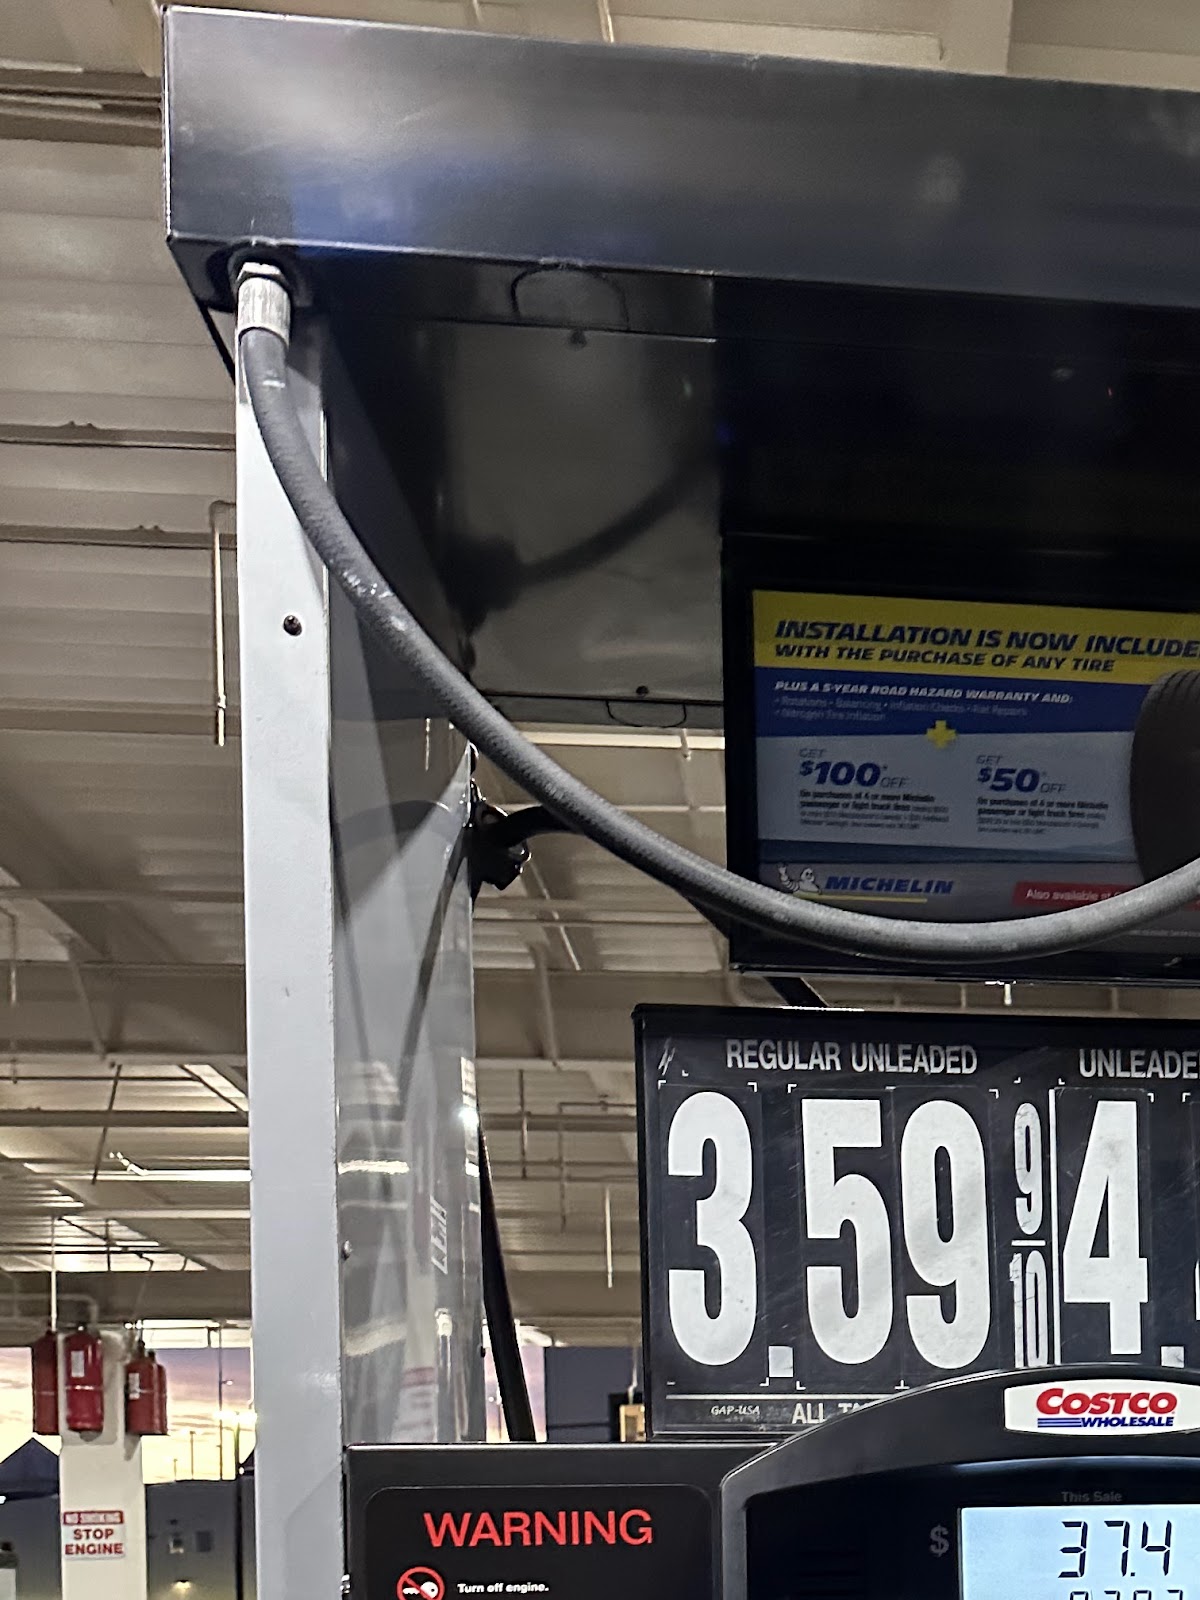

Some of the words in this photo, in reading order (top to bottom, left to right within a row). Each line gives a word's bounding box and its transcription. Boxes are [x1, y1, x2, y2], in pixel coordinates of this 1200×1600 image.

[775, 620, 972, 645] INSTALLATION
[976, 630, 1003, 647] IS
[1006, 631, 1079, 651] NOW
[775, 644, 829, 659] WITH
[837, 647, 875, 660] THE
[879, 649, 987, 666] PURCHASE
[992, 654, 1017, 667] OF
[1022, 656, 1066, 670] ANY
[1072, 658, 1115, 672] TIRE
[775, 681, 807, 691] PLUS
[809, 682, 820, 691] A
[822, 683, 868, 694] 5-YEAR
[871, 686, 907, 695] ROAD
[909, 687, 962, 698] HAZARD
[965, 688, 1040, 703] WARRANTY
[825, 876, 954, 893] MICHELIN
[1026, 888, 1050, 900] Also
[1053, 890, 1099, 901] available
[725, 1039, 842, 1071] REGULAR
[850, 1042, 978, 1075] UNLEADED
[667, 1091, 991, 1378] 3.59
[710, 1405, 761, 1417] GAP-USA
[1037, 1388, 1175, 1415] COSTCO
[792, 1404, 825, 1424] ALL
[1080, 1415, 1174, 1428] WHOLESALE
[1061, 1491, 1090, 1503] This
[1094, 1490, 1122, 1502] Sale
[74, 1528, 114, 1540] STOP
[423, 1509, 653, 1547] WARNING
[65, 1543, 123, 1555] ENGINE
[930, 1524, 949, 1557] $
[458, 1583, 484, 1594] Turn
[487, 1583, 503, 1593] off
[506, 1583, 549, 1594] engine.
